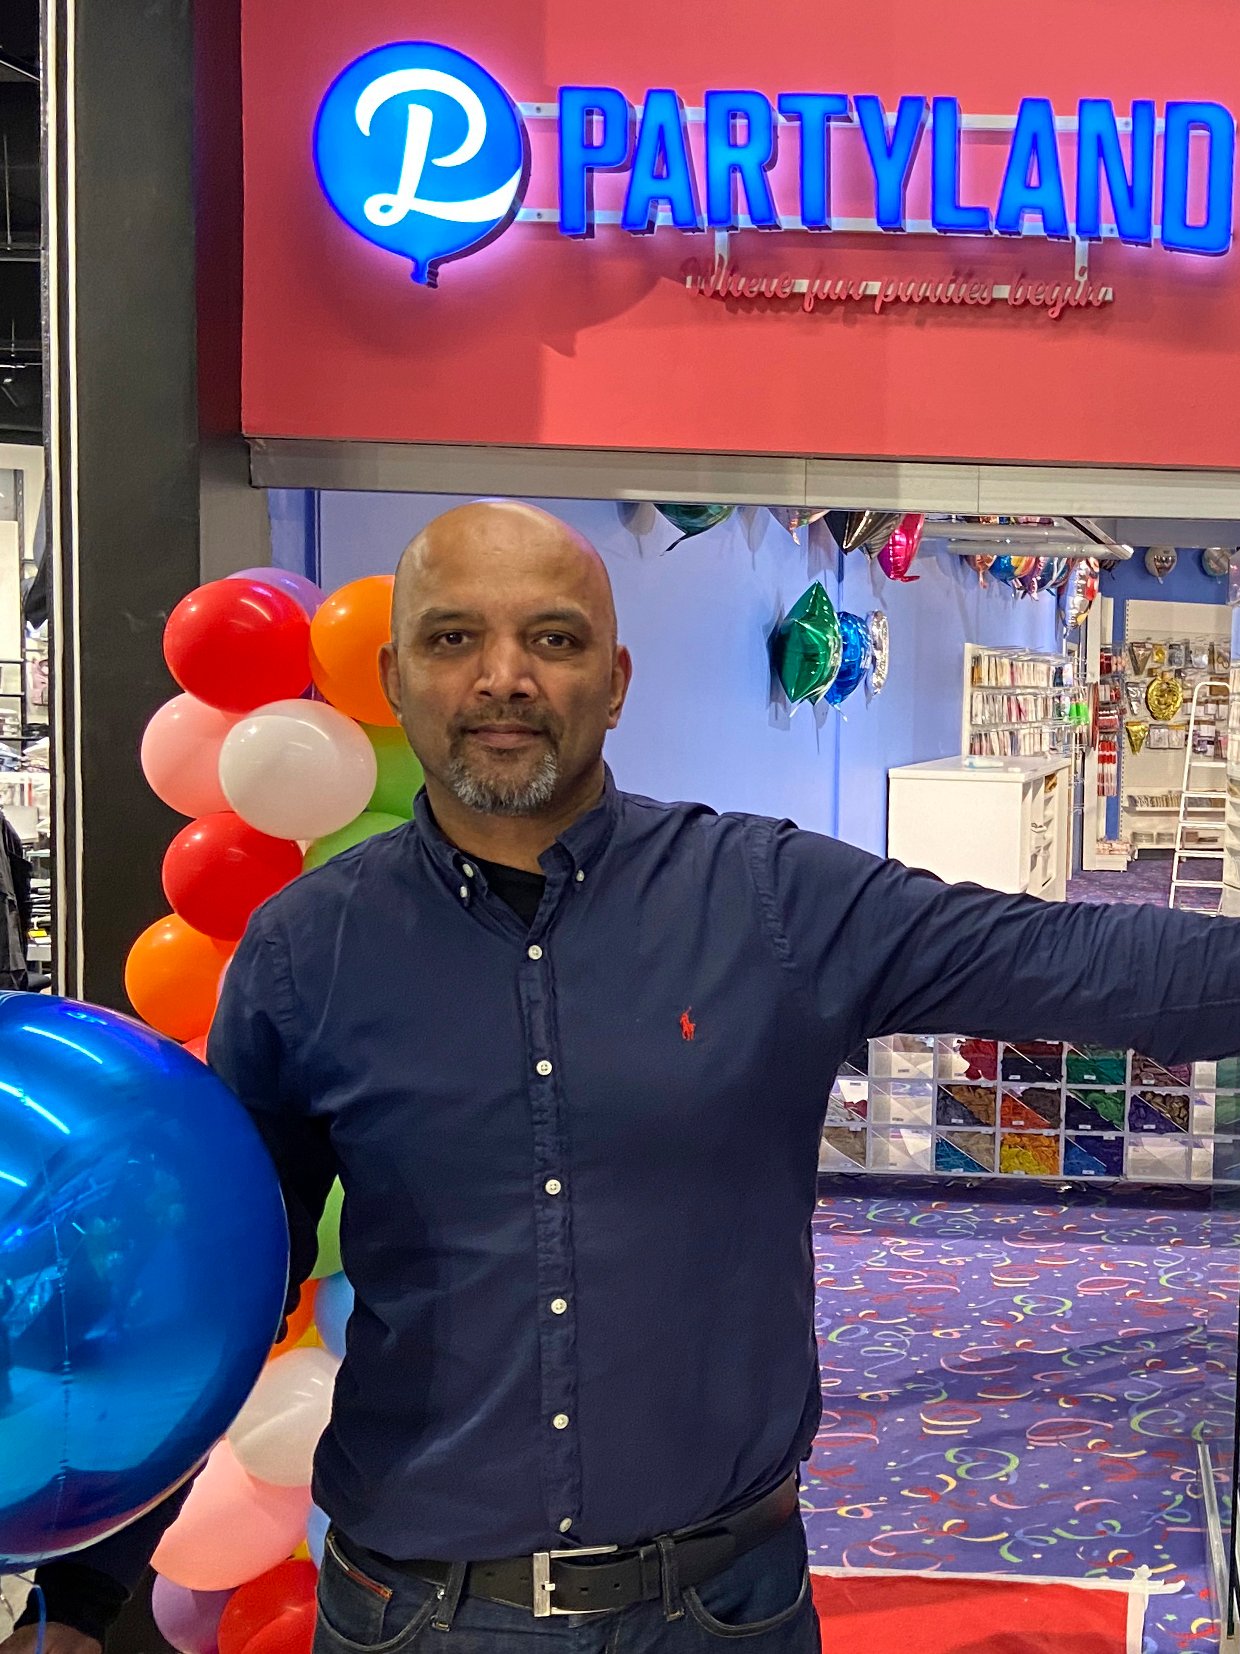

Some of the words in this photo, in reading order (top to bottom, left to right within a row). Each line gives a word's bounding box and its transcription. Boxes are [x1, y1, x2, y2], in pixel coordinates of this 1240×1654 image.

[355, 68, 521, 226] P
[558, 86, 1236, 254] PARTYLAND
[803, 259, 867, 313] fun
[873, 267, 993, 314] parties
[1007, 264, 1108, 318] begin
